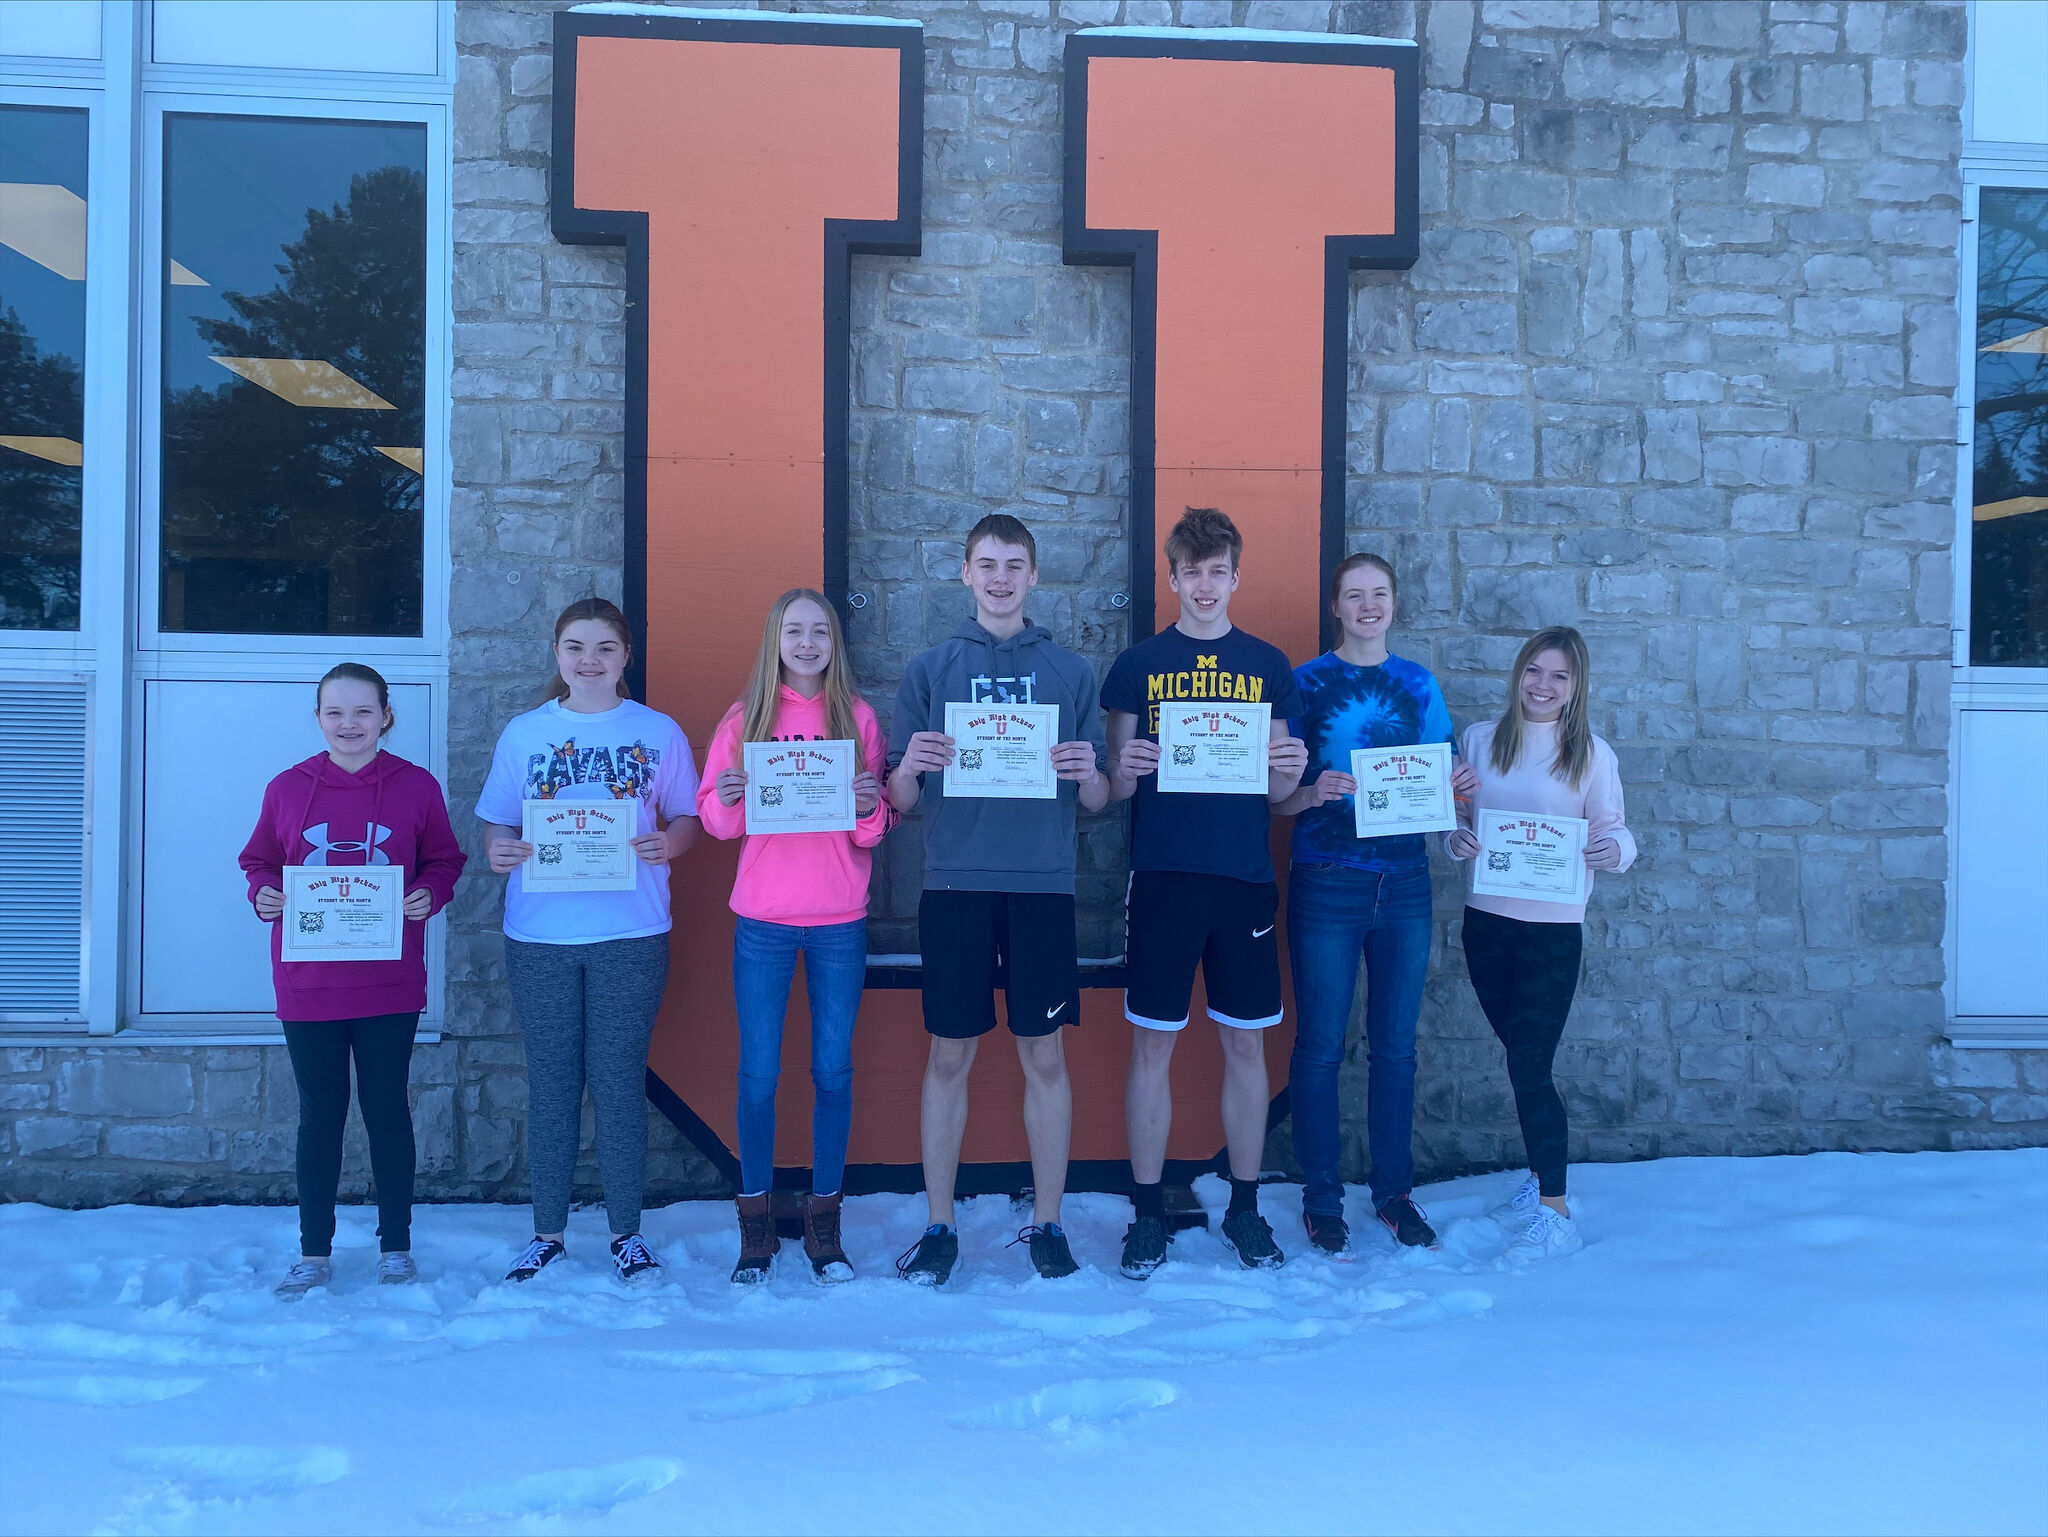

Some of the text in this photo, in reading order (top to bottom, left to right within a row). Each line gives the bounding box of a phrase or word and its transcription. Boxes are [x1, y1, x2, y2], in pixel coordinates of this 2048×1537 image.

[1196, 655, 1218, 669] M
[1147, 671, 1264, 703] MICHIGAN
[1010, 714, 1036, 730] School
[1209, 719, 1221, 732] U
[1223, 712, 1248, 727] School
[996, 722, 1008, 735] U
[787, 750, 805, 758] High
[808, 751, 834, 764] School
[1389, 755, 1407, 763] High
[1409, 755, 1432, 768] School
[794, 758, 806, 771] U
[1397, 762, 1408, 775] U
[589, 809, 616, 824] School
[575, 817, 587, 830] U
[1518, 820, 1537, 828] High
[1540, 822, 1566, 839] School
[1525, 828, 1537, 841] U
[354, 876, 381, 891] School
[338, 884, 351, 897] U
